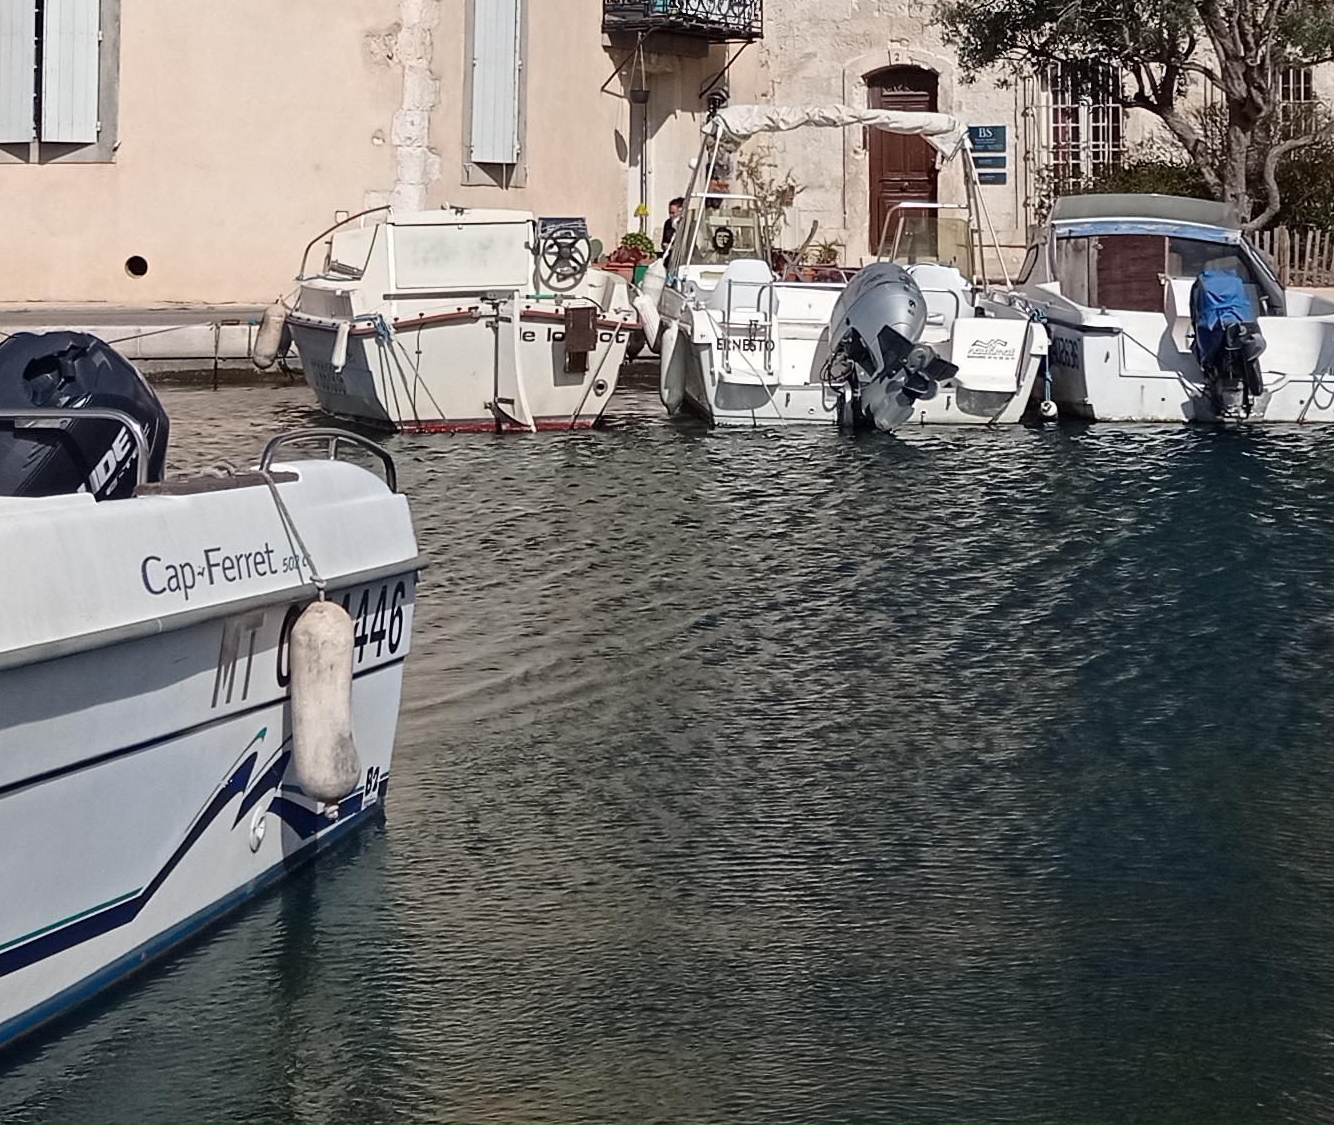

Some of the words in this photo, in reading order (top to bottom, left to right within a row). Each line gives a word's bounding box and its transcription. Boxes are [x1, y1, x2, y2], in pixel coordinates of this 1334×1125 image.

[978, 127, 993, 138] BS
[717, 338, 775, 352] ERNESTO
[211, 613, 265, 708] MT
